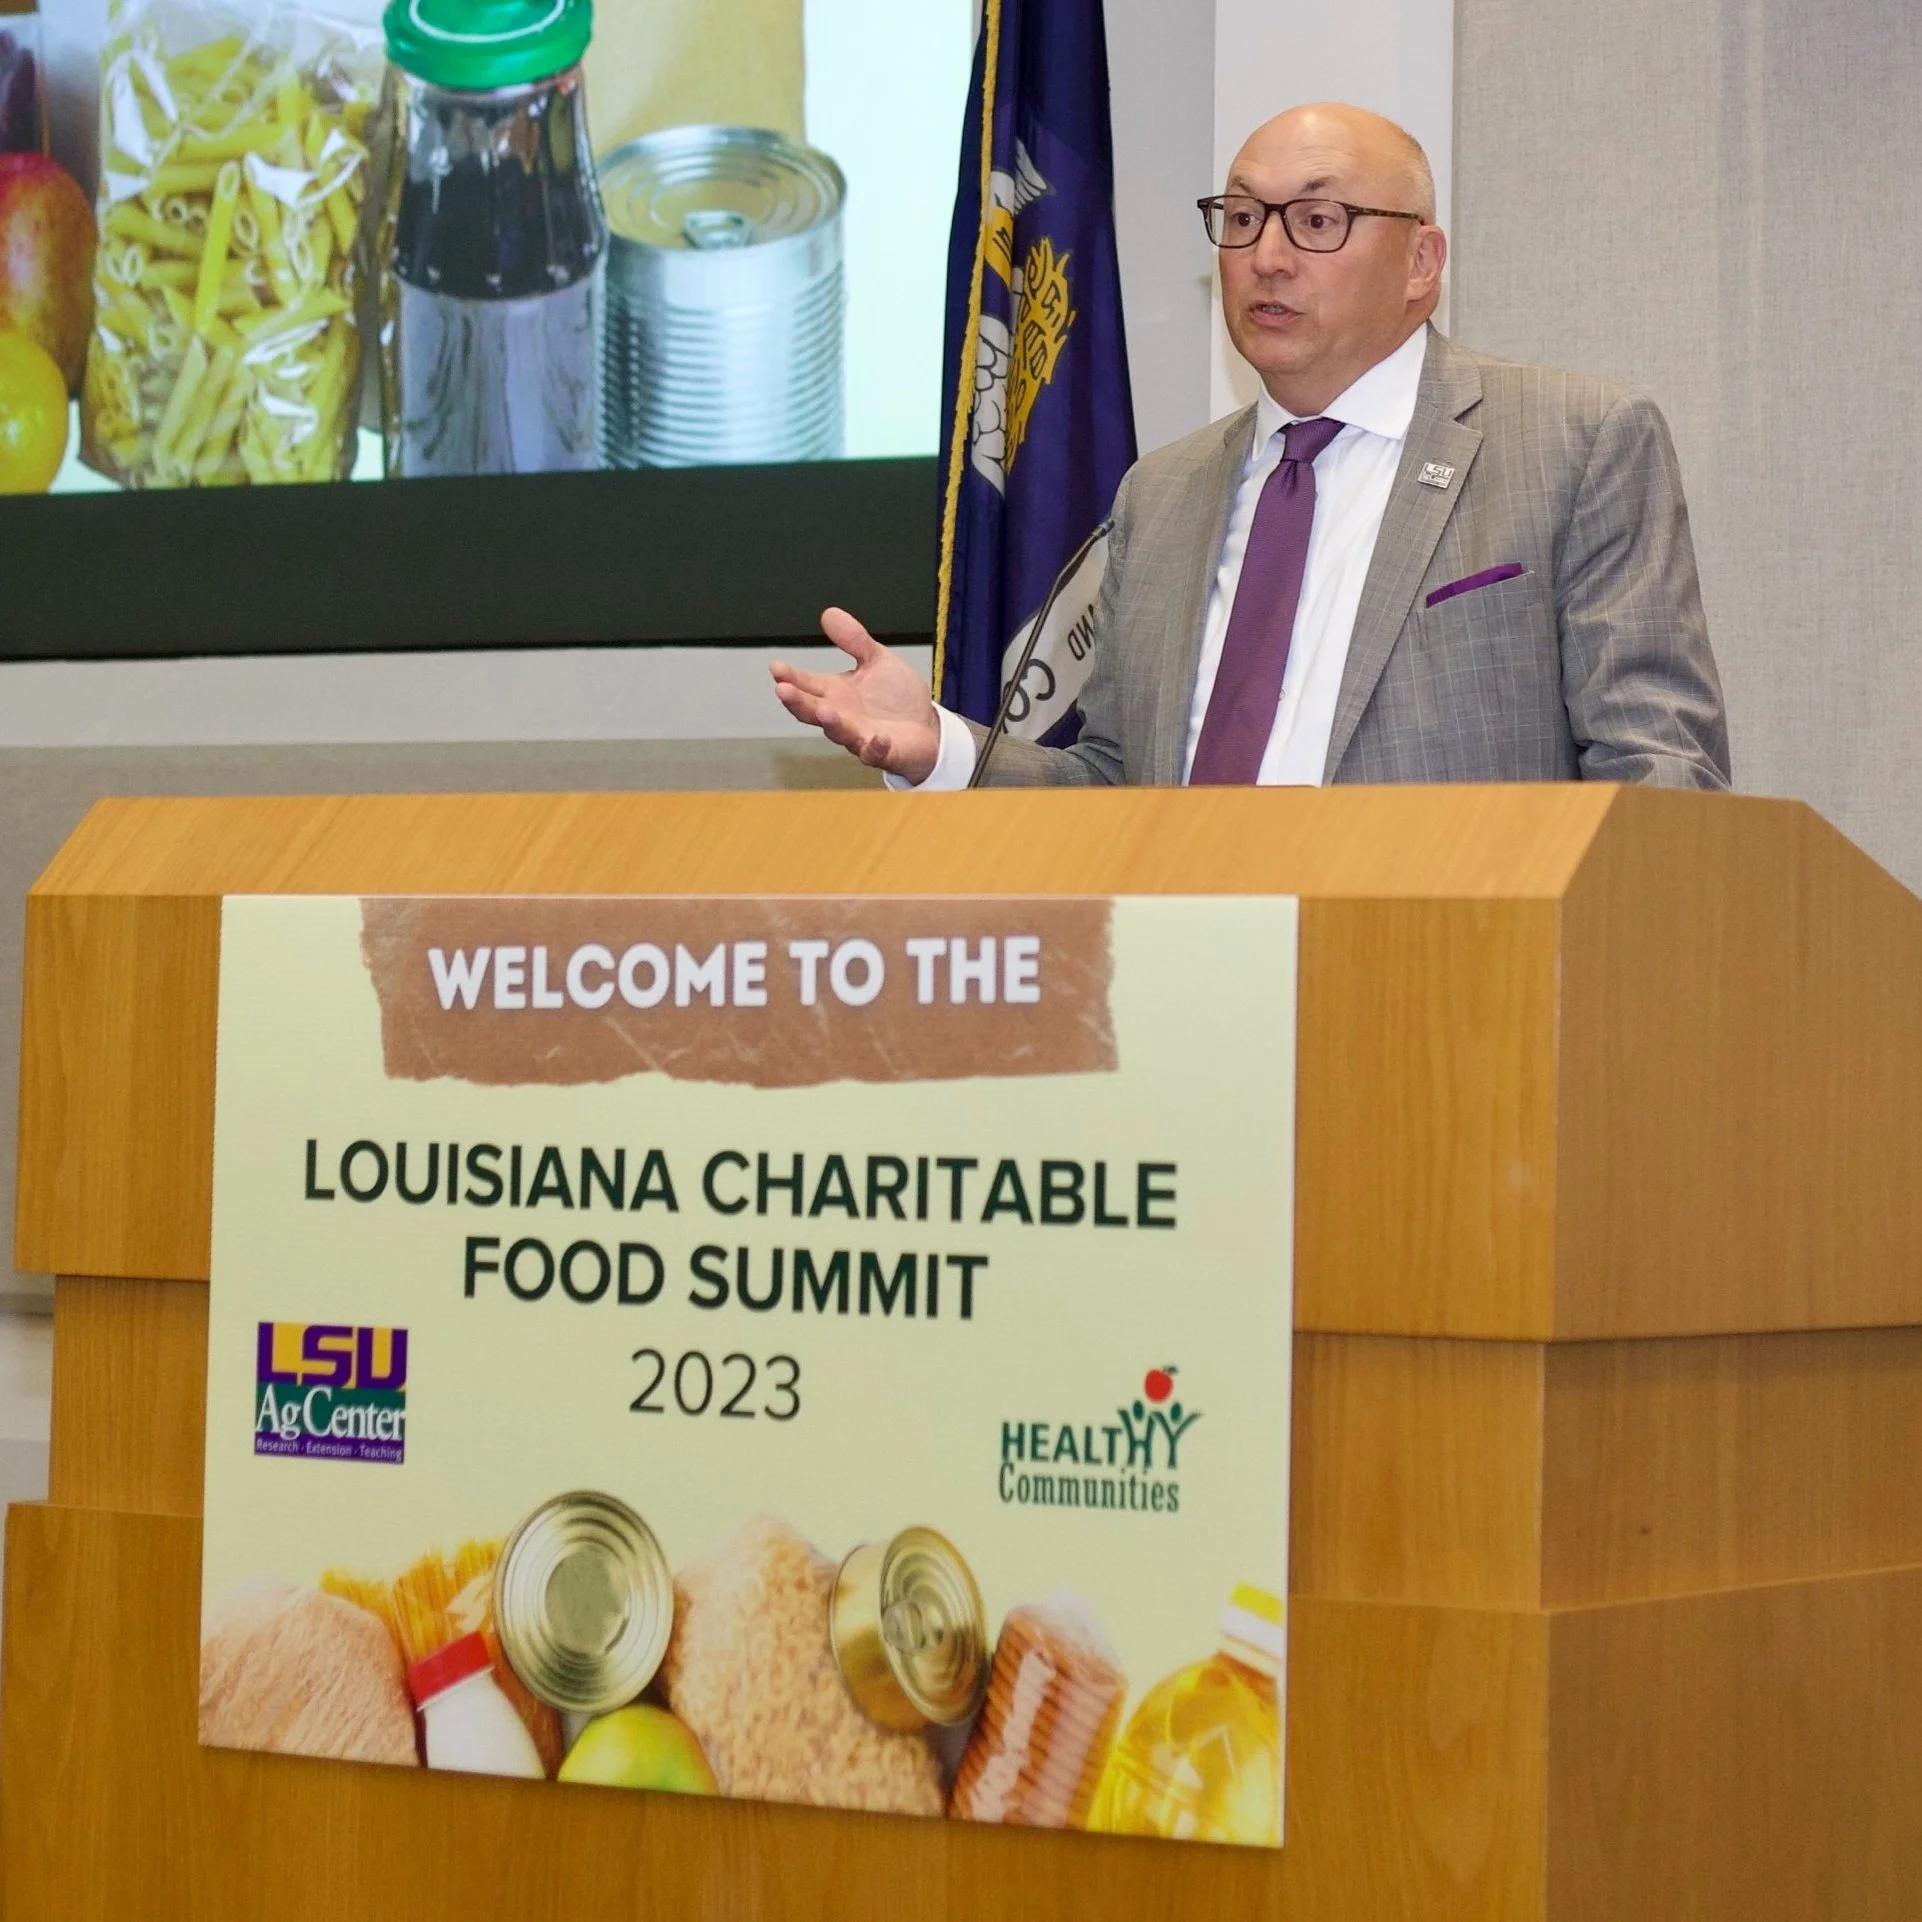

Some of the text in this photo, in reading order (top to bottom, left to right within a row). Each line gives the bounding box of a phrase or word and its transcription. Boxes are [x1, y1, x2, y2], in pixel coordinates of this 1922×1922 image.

[428, 935, 1040, 1010] WELCOME TO THE
[305, 1139, 1177, 1229] LOUISIANA CHARITABLE
[464, 1236, 988, 1320] FOOD SUMMIT
[257, 1322, 408, 1391] LSU
[630, 1348, 801, 1421] 2023
[255, 1383, 407, 1441] AgCenter
[1002, 1409, 1202, 1470] HEALTHY
[256, 1439, 402, 1462] Research Extension Teaching
[1000, 1461, 1179, 1512] Communities
